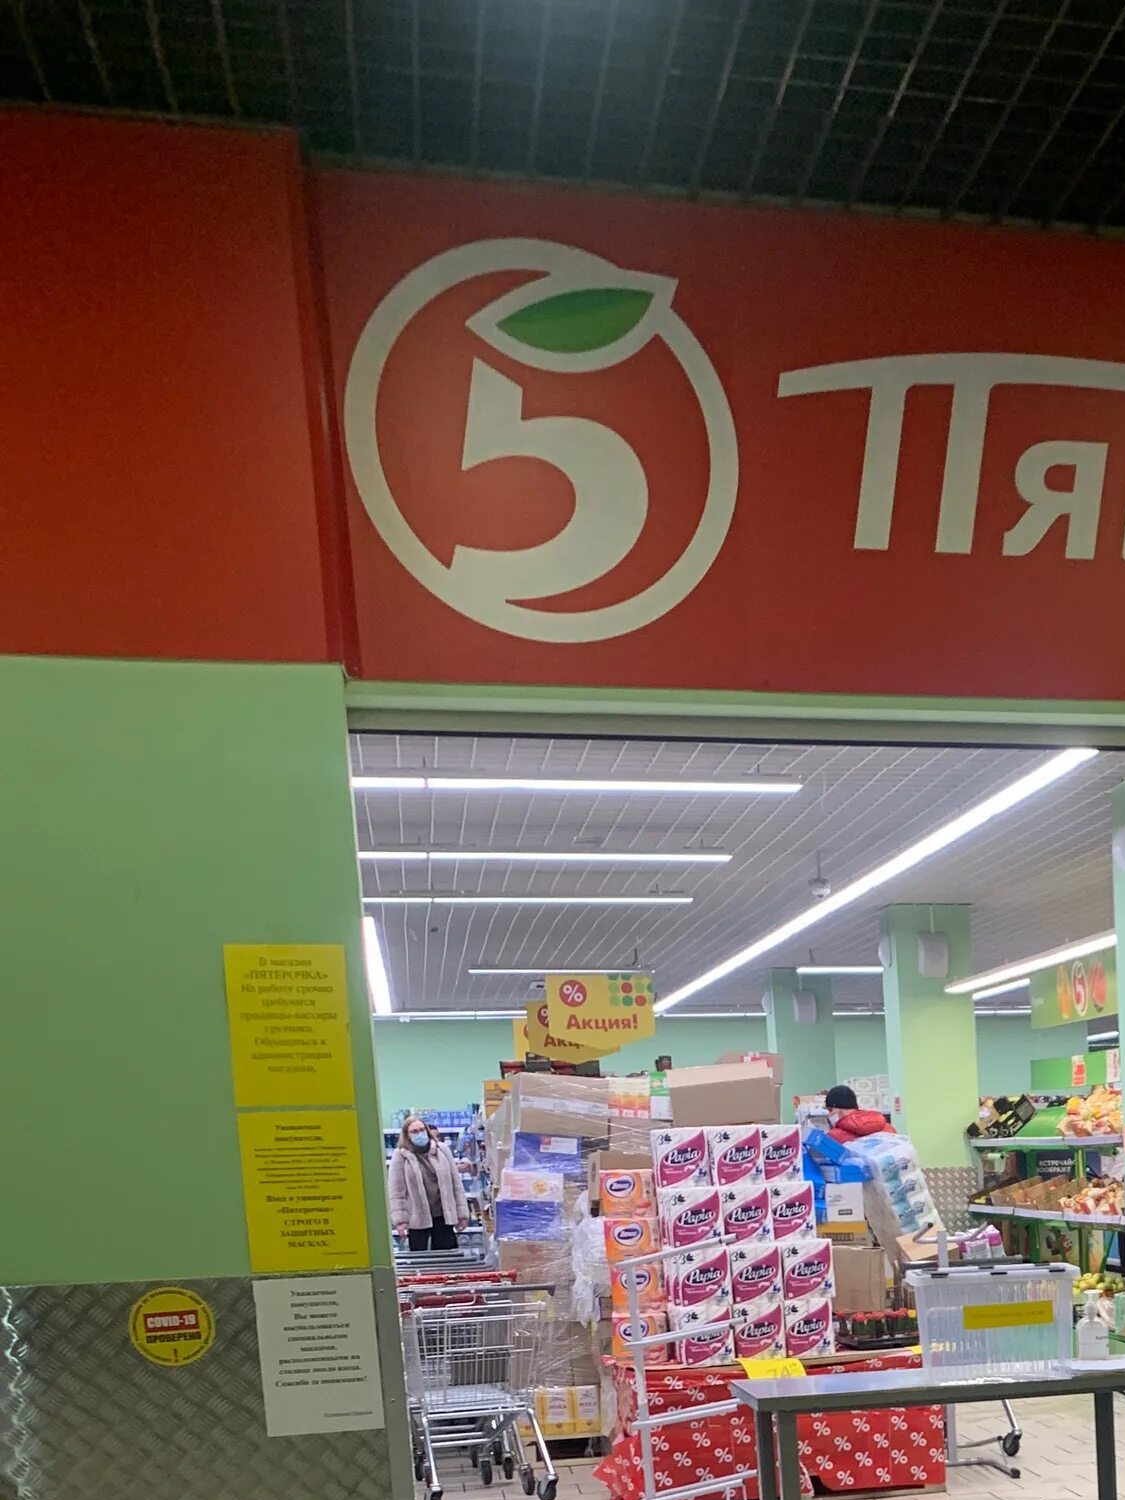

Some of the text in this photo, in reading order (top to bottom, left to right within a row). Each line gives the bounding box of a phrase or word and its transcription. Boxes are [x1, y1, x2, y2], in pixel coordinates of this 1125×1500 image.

[566, 1014, 638, 1032] Акция!
[667, 1148, 698, 1164] Papia
[725, 1146, 756, 1162] Papia
[764, 1144, 793, 1161] Papia
[681, 1208, 712, 1225] Papia
[731, 1206, 762, 1223] Papia
[776, 1202, 806, 1219] Papia
[689, 1267, 720, 1284] Papia
[742, 1265, 774, 1281] Papia
[794, 1261, 826, 1278] Papia
[146, 1314, 197, 1328] COVID-19
[794, 1319, 824, 1335] Papia
[745, 1322, 775, 1338] Papia
